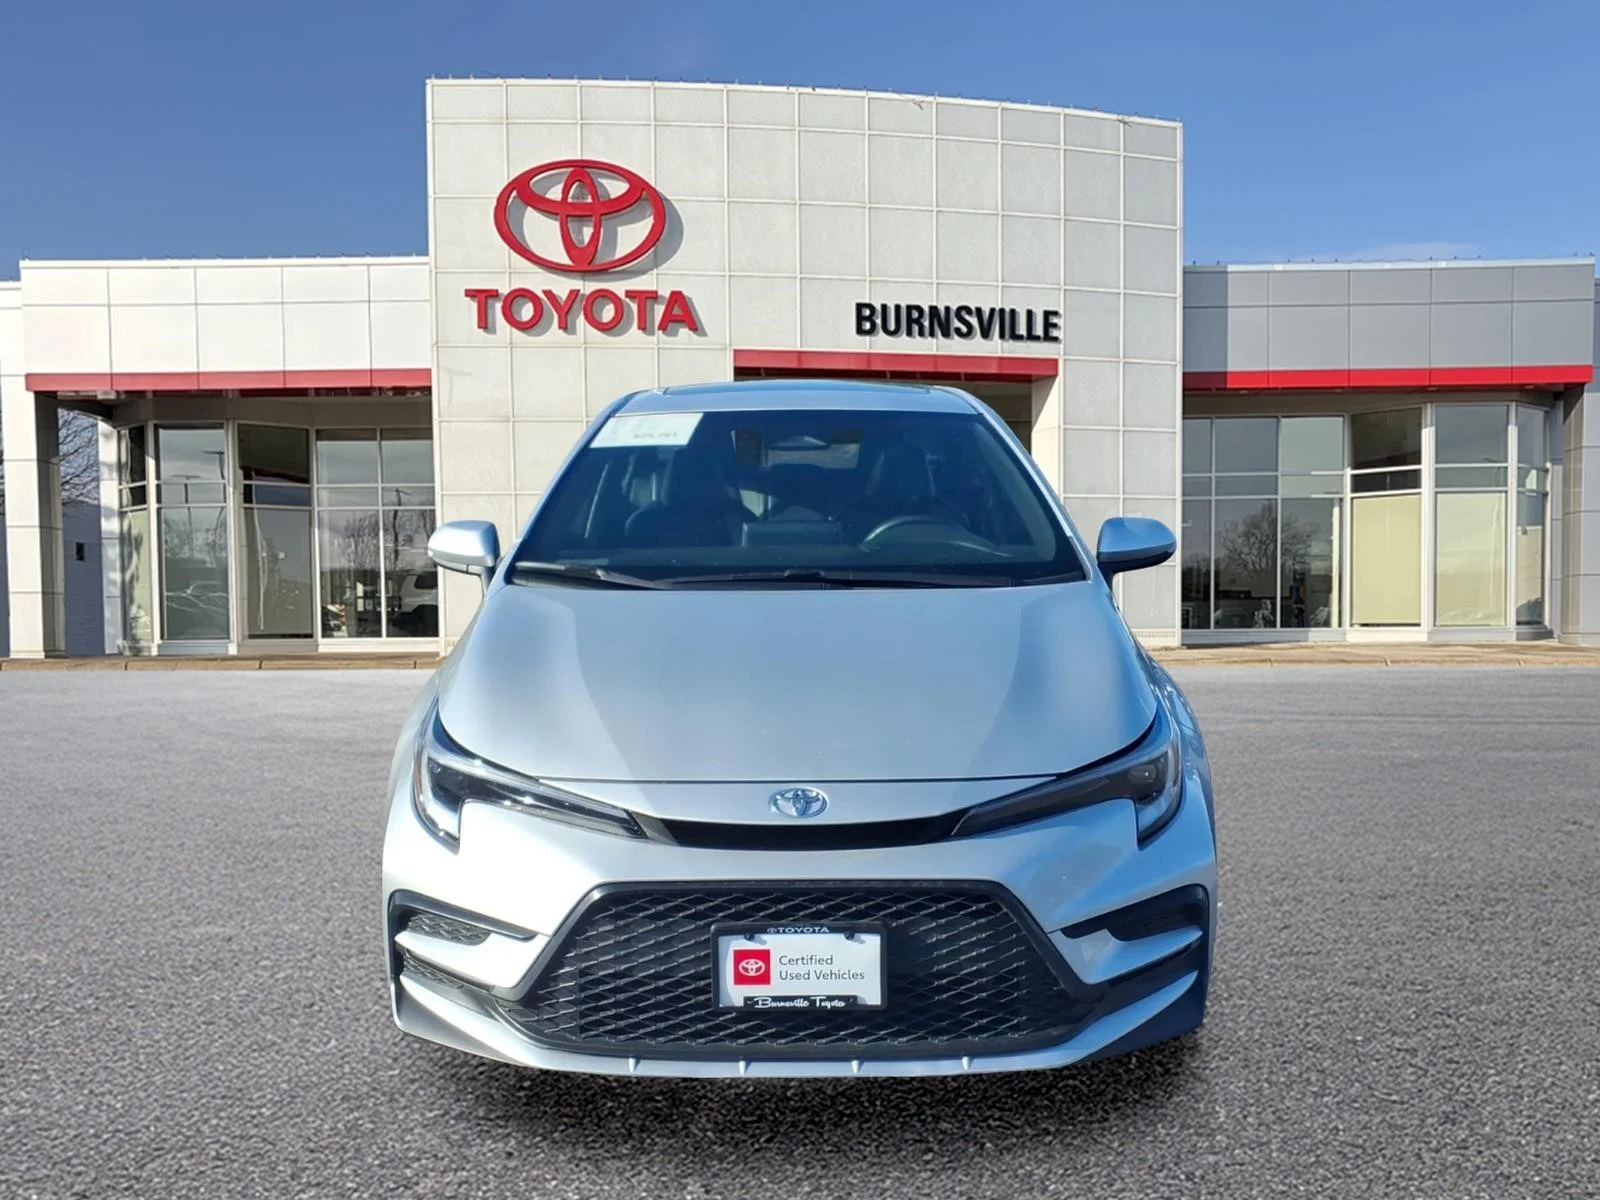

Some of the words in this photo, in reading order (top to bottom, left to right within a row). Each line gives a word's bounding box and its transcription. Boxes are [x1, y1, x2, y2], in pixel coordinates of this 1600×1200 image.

[465, 287, 699, 332] TOYOTA
[855, 302, 1060, 342] BURNSVILLE
[778, 954, 834, 966] Certified
[779, 970, 811, 981] Used
[813, 969, 865, 980] Vehicles
[753, 996, 809, 1008] Burnsville
[810, 996, 846, 1009] Toyota
